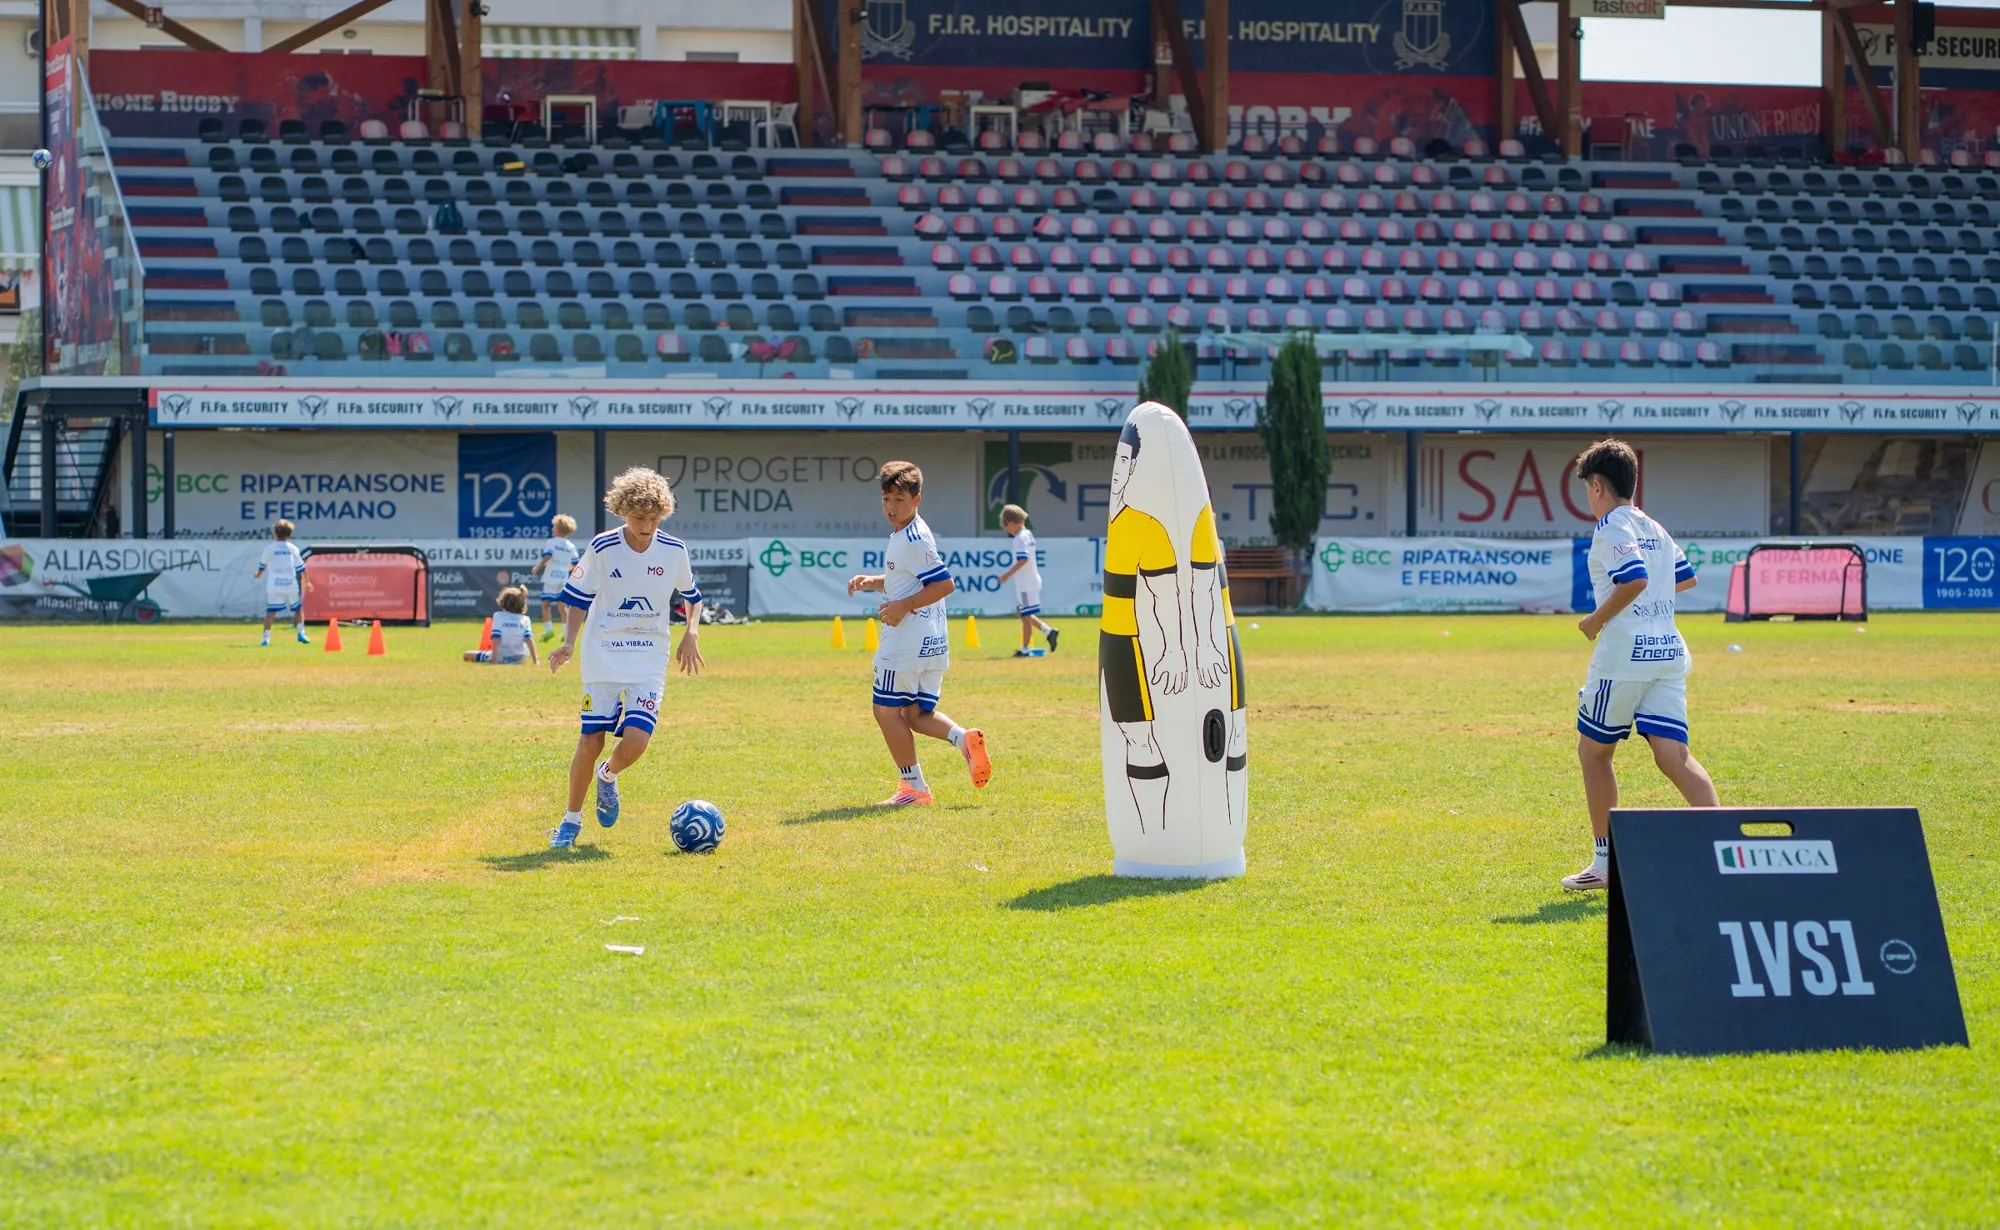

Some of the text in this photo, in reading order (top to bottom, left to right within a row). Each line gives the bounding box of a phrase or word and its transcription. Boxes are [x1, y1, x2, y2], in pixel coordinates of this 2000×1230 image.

[928, 14, 1133, 38] F.I.R. HOSPITALITY
[1239, 21, 1381, 43] HOSPITALITY
[232, 402, 288, 413] SECURITY
[368, 402, 423, 414] SECURITY
[504, 402, 558, 414] SECURITY
[638, 403, 692, 414] SECURITY
[772, 404, 825, 415] SECURITY
[903, 404, 956, 416] SECURITY
[1034, 405, 1085, 416] SECURITY
[1414, 406, 1464, 417] SECURITY
[1538, 406, 1588, 418] SECURITY
[1661, 406, 1710, 418] SECURITY
[1781, 407, 1830, 418] SECURITY
[1900, 408, 1947, 419] SECURITY
[692, 456, 878, 483] PROGETTO
[176, 473, 445, 493] BCC RIPATRANSONE
[464, 472, 551, 517] 120
[694, 488, 793, 512] TENDA
[241, 501, 397, 520] E FERMANO
[43, 549, 220, 572] ALIASDIGITAL
[484, 549, 504, 561] SU
[800, 551, 847, 568] BCC
[1352, 550, 1553, 566] BCC RIPATRANSONE
[1934, 547, 1995, 582] 120
[1402, 571, 1517, 586] E FERMANO
[1631, 646, 1684, 661] Energie
[1749, 848, 1830, 868] ITACA
[1718, 920, 1876, 998] 1VS1
